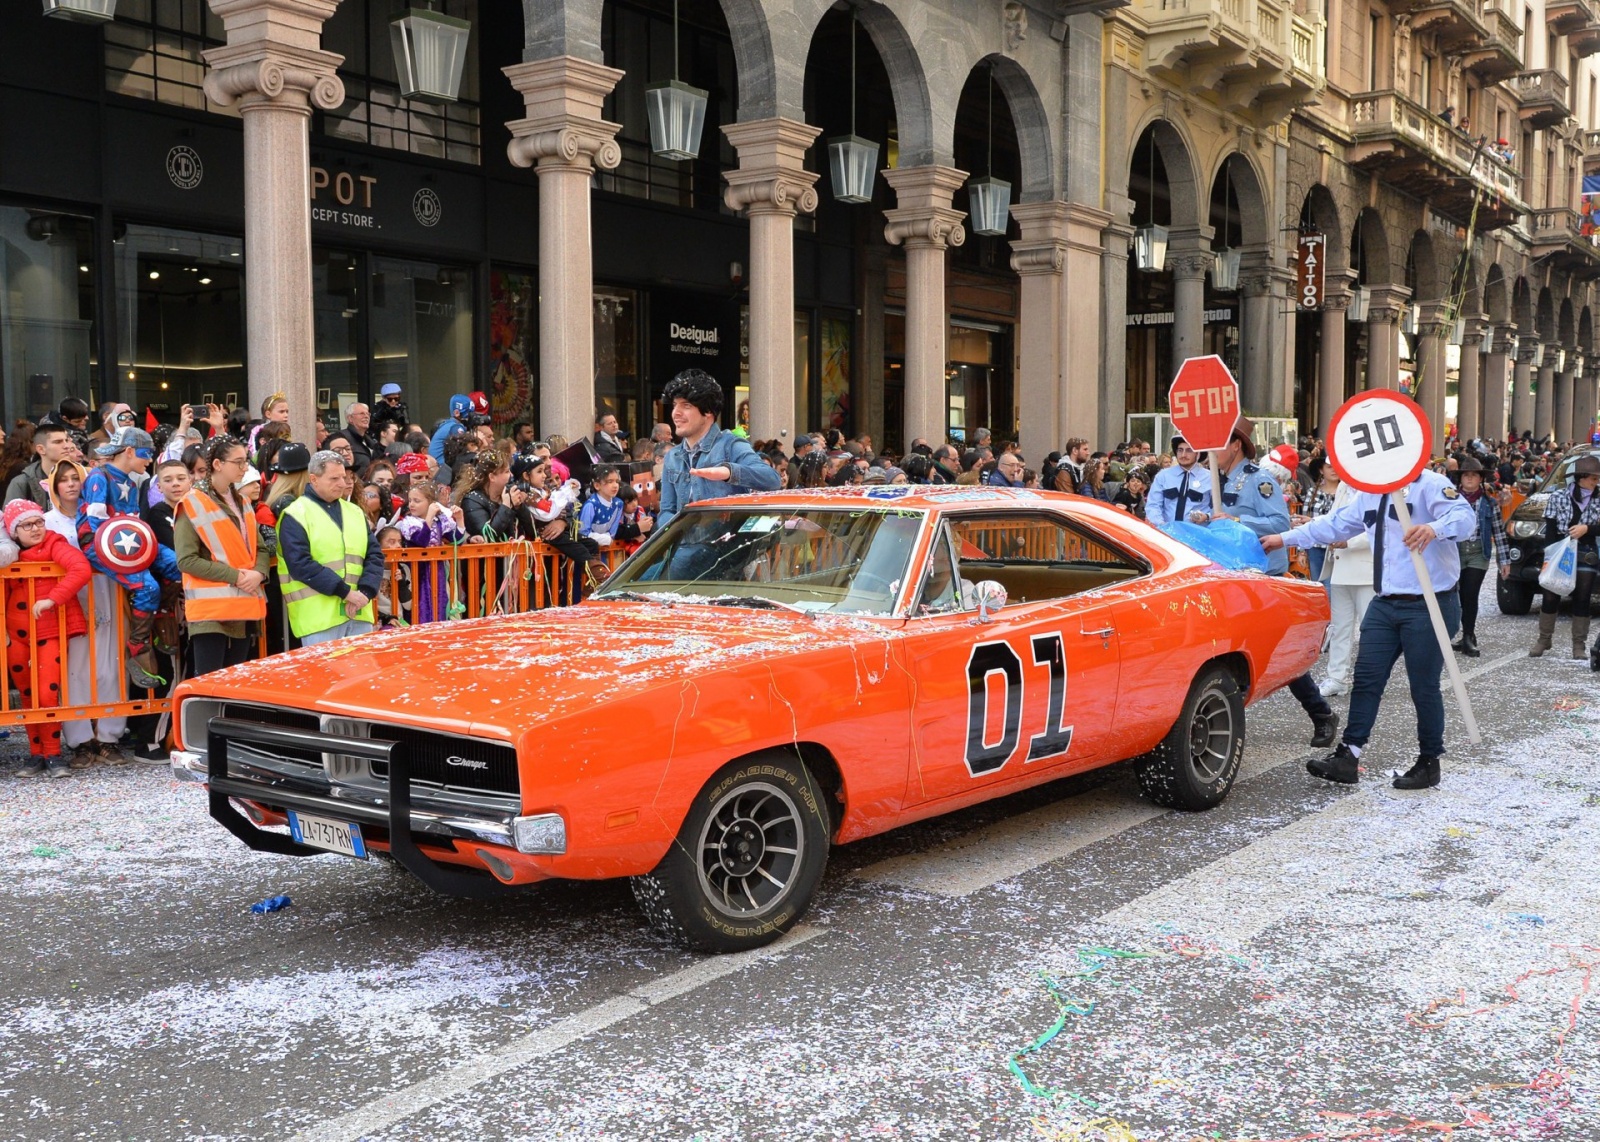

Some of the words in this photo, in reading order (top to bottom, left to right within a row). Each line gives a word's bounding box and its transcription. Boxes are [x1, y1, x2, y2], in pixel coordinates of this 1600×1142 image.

[310, 167, 377, 208] POT
[1303, 242, 1318, 307] TATTOO
[670, 322, 718, 344] Desigual
[1126, 313, 1143, 325] KY
[702, 347, 719, 356] dealer
[1173, 385, 1235, 419] STOP
[1349, 414, 1404, 459] 30
[964, 631, 1074, 778] 01
[446, 756, 489, 770] Charger
[1226, 738, 1243, 779] RADIAL
[708, 765, 798, 802] GRABBER
[703, 906, 789, 937] GENERAL
